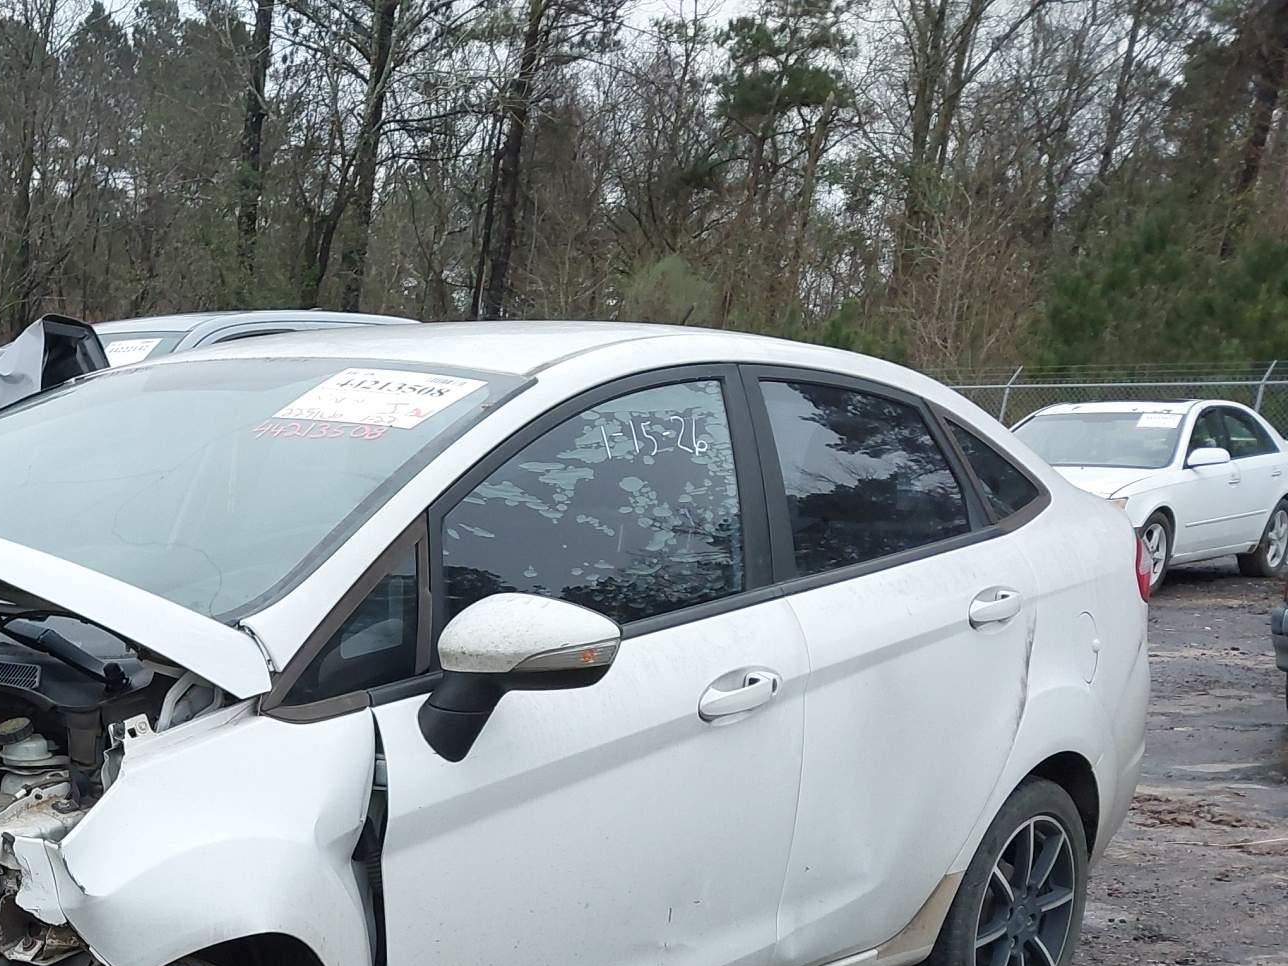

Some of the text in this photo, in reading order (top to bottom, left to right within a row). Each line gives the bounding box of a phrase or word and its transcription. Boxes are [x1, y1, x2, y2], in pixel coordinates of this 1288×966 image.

[335, 378, 451, 398] 44213508
[251, 420, 389, 440] 44213508
[600, 414, 708, 460] 1-15-26
